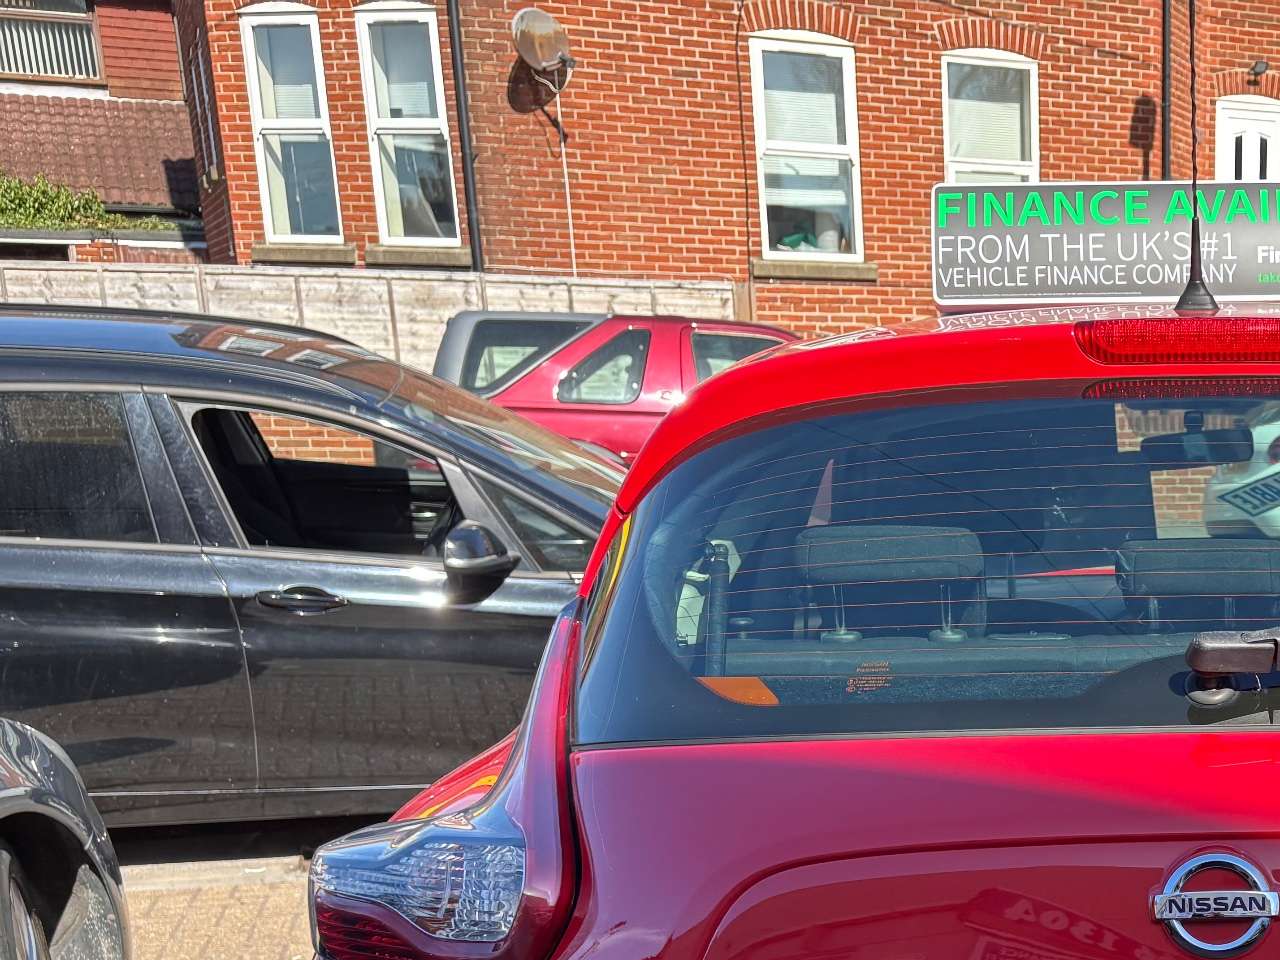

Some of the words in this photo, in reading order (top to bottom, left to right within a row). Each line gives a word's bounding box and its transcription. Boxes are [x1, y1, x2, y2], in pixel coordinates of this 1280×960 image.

[938, 190, 1151, 228] FINANCE
[938, 233, 1030, 264] FROM
[1040, 232, 1107, 262] THE
[1117, 231, 1192, 262] UK'S
[1200, 231, 1237, 261] #1
[938, 266, 1029, 288] VEHICLE
[1035, 264, 1127, 286] FINANCE
[1168, 896, 1266, 914] NISSAN
